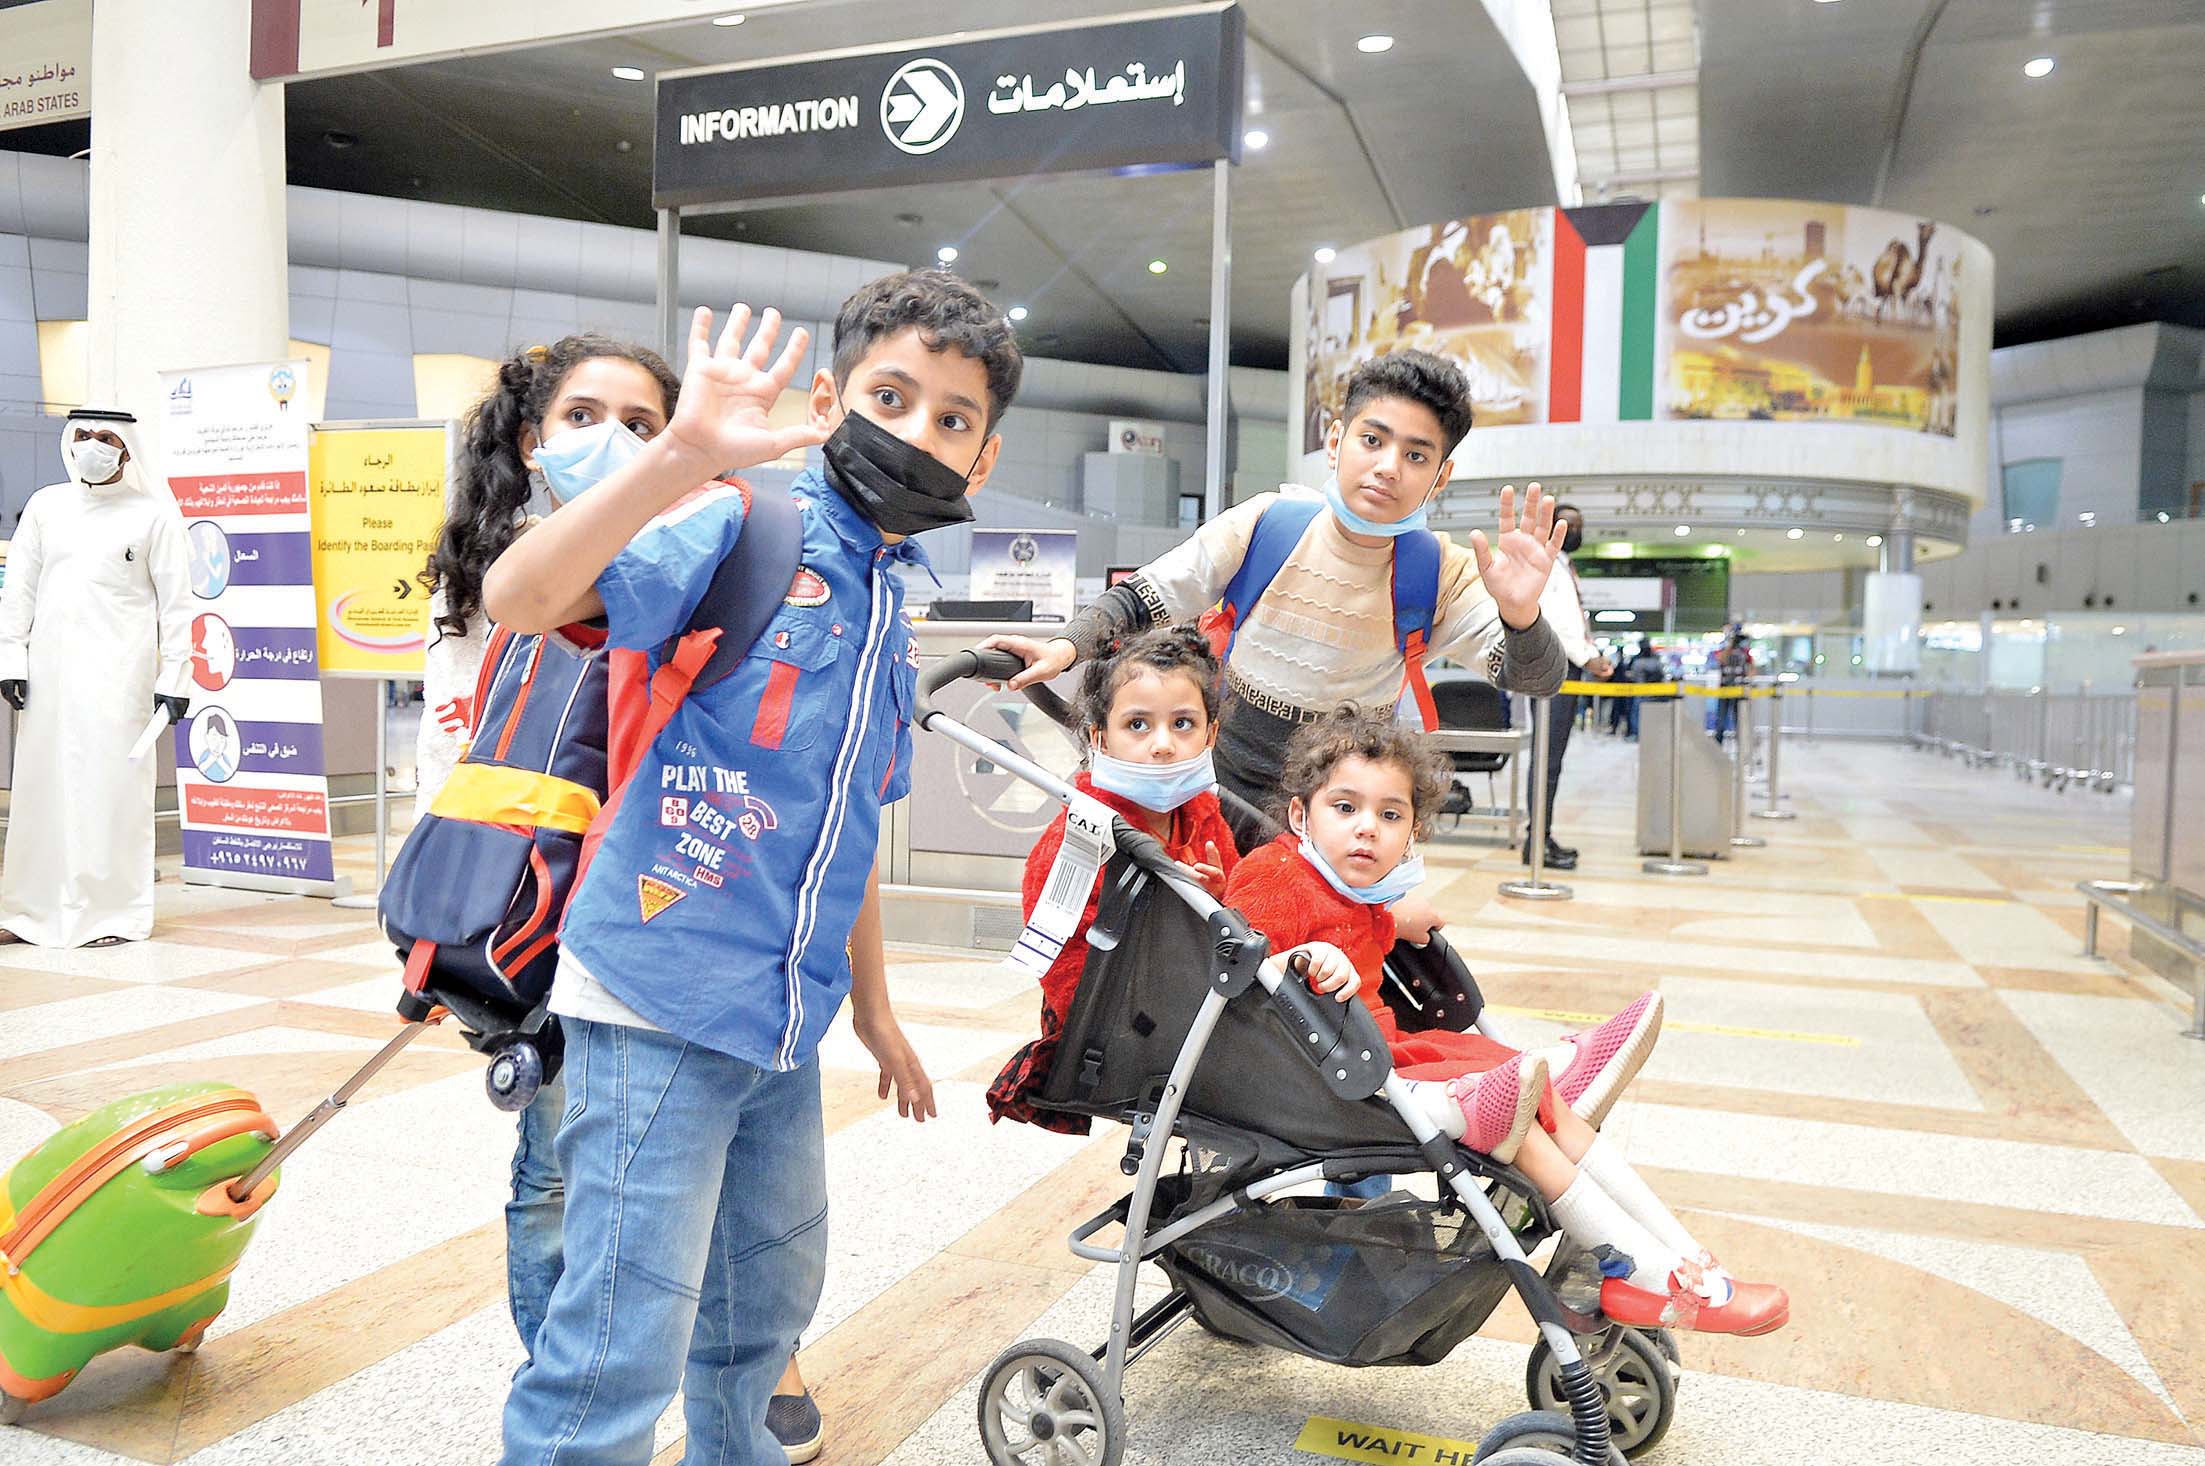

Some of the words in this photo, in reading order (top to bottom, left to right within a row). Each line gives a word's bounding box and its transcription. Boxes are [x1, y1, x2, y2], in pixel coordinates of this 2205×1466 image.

[28, 63, 75, 87] مواطنو
[987, 59, 1185, 115] إستعلامات
[4, 100, 33, 117] ARAB
[37, 92, 79, 112] STATES
[680, 96, 859, 145] INFORMATION
[1680, 259, 1827, 343] كويت
[363, 453, 393, 469] الرجاء
[320, 480, 356, 497] الطائرة
[359, 484, 386, 497] صعود
[389, 479, 420, 496] بطاقة
[362, 517, 393, 529] Please
[233, 549, 259, 563] السعال
[318, 541, 351, 554] Identify
[354, 541, 369, 551] the
[371, 540, 414, 554] Boarding
[235, 647, 261, 662] الحرارة
[263, 646, 282, 662] درجة
[661, 764, 707, 793] PLAY
[713, 767, 749, 794] THE
[689, 800, 737, 841] BEST
[675, 832, 726, 871] ZONE
[652, 864, 697, 888] ANTARCTICA
[696, 868, 721, 886] HMS
[1338, 1431, 1426, 1458] WAIT
